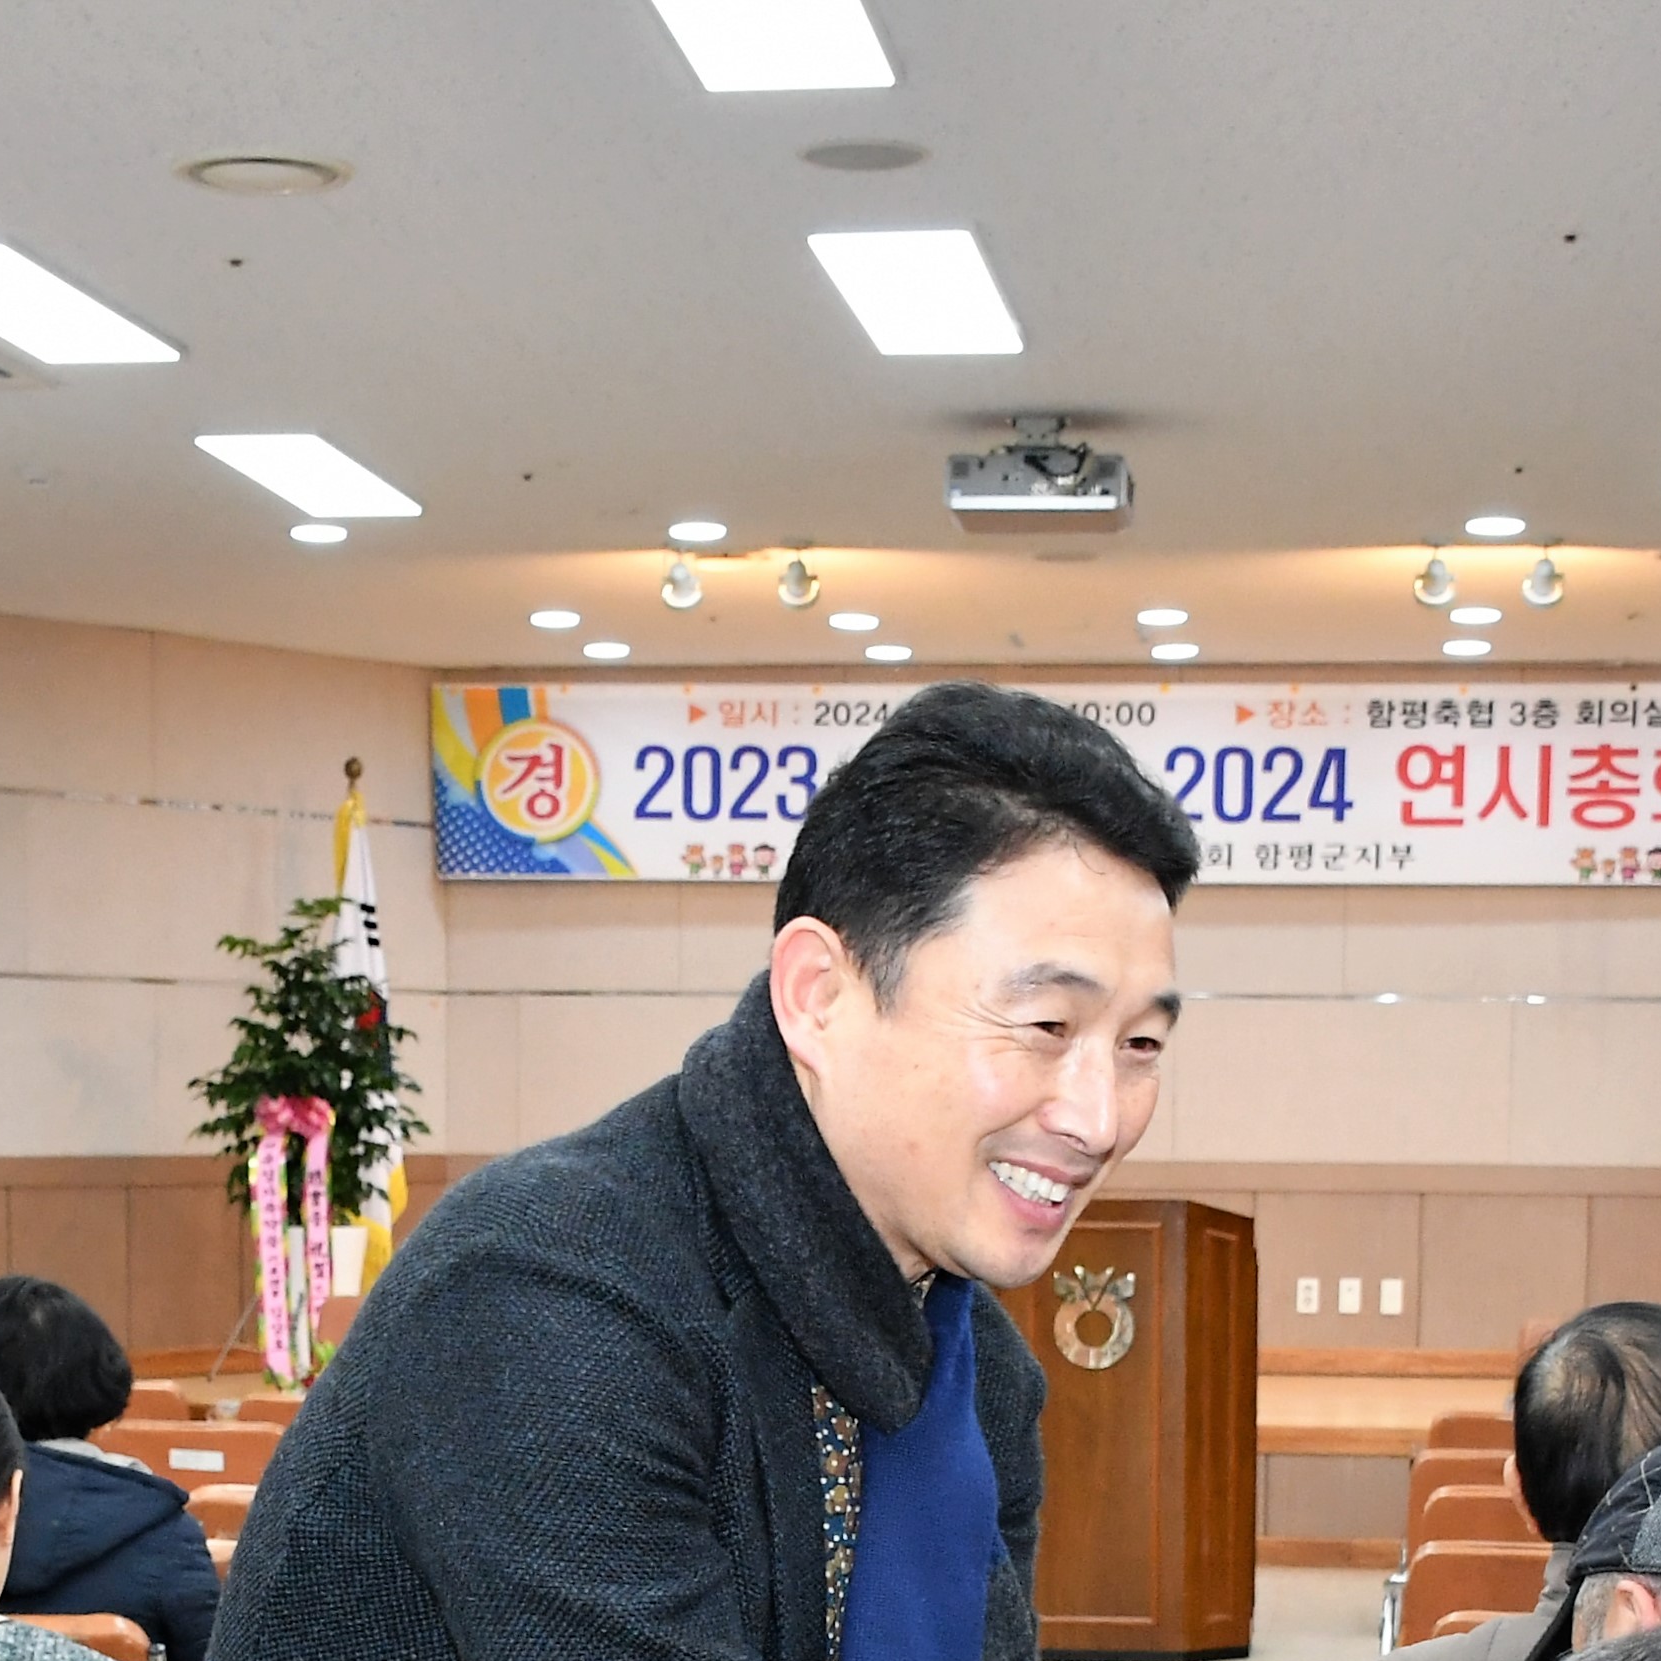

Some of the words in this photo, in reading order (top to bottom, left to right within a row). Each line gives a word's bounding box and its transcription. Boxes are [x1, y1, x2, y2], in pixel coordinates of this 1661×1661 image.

[719, 701, 778, 730] 일시
[1267, 700, 1328, 729] 장소
[1366, 700, 1495, 729] 함평축협
[1509, 699, 1559, 728] 3층
[502, 741, 564, 821] 경
[633, 744, 819, 821] 2023
[1163, 745, 1354, 823] 2024
[1255, 842, 1416, 871] 함평군지부
